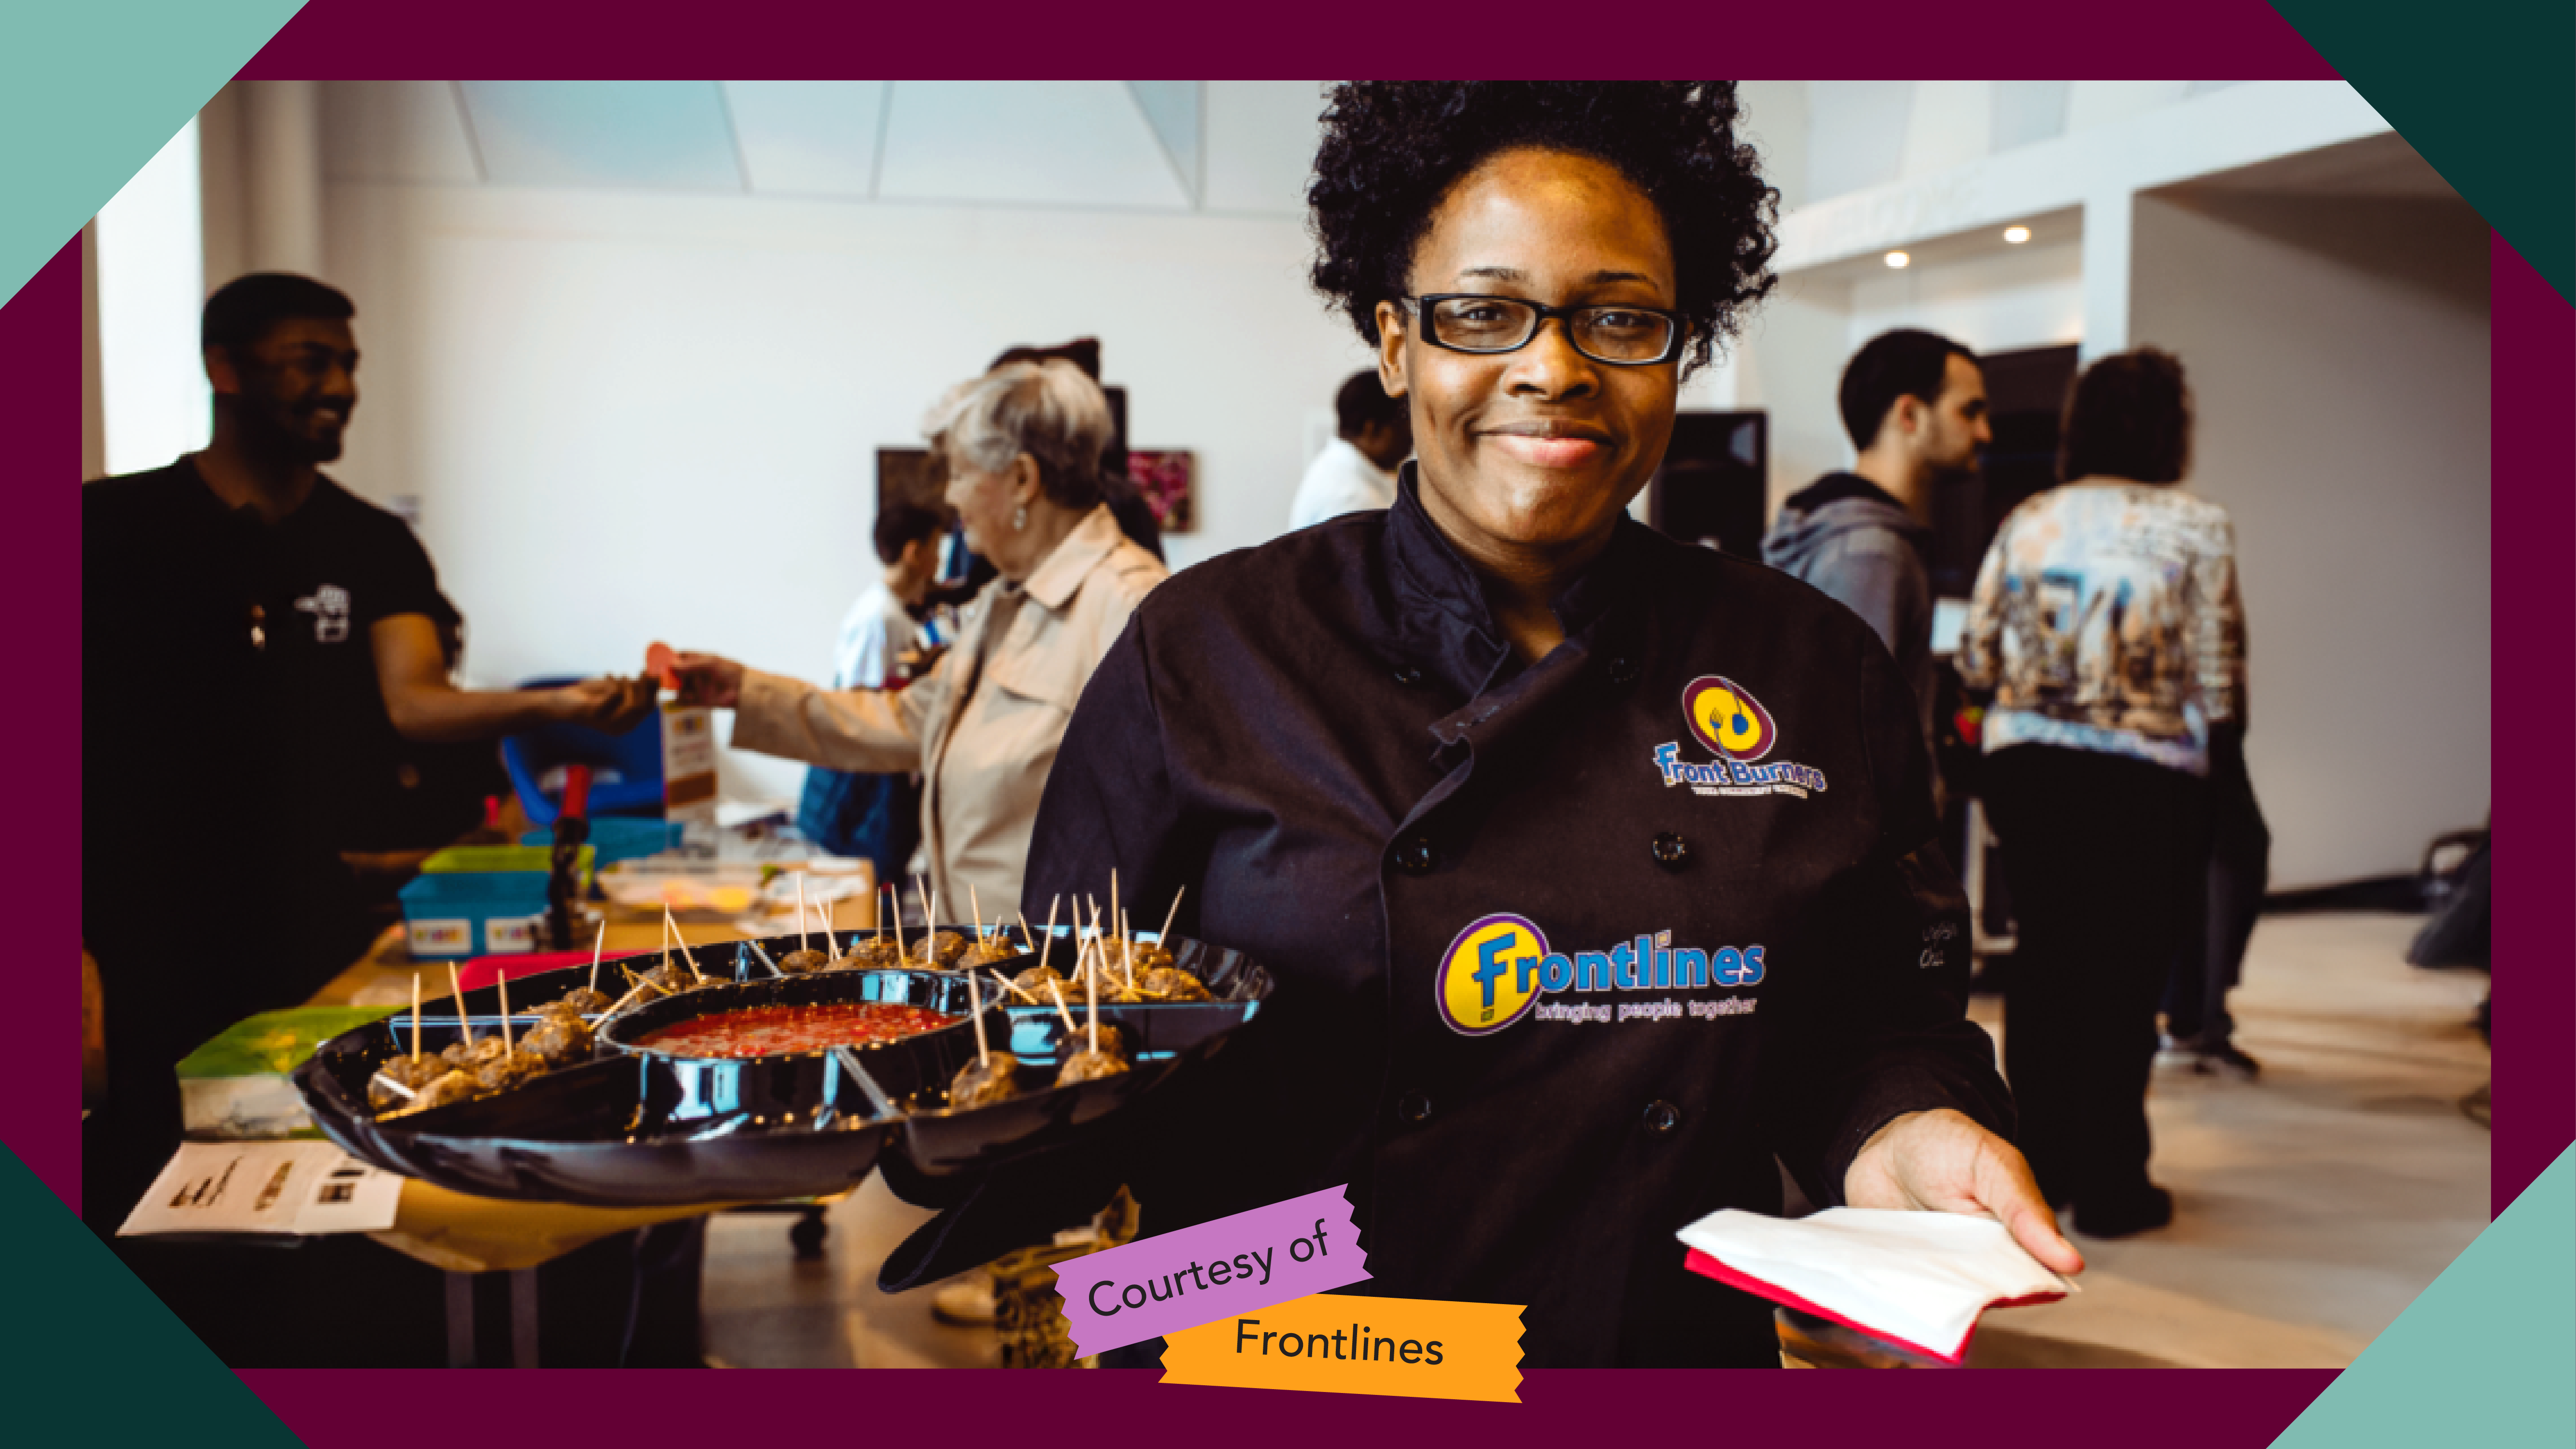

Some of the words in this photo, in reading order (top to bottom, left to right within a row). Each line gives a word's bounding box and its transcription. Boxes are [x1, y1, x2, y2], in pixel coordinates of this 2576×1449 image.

[1653, 740, 1732, 787] Front
[1727, 760, 1827, 792] Burners
[1472, 928, 1766, 1009] Frontlines
[1535, 1000, 1611, 1024] bringing
[1618, 997, 1683, 1023] people
[1689, 995, 1757, 1021] together
